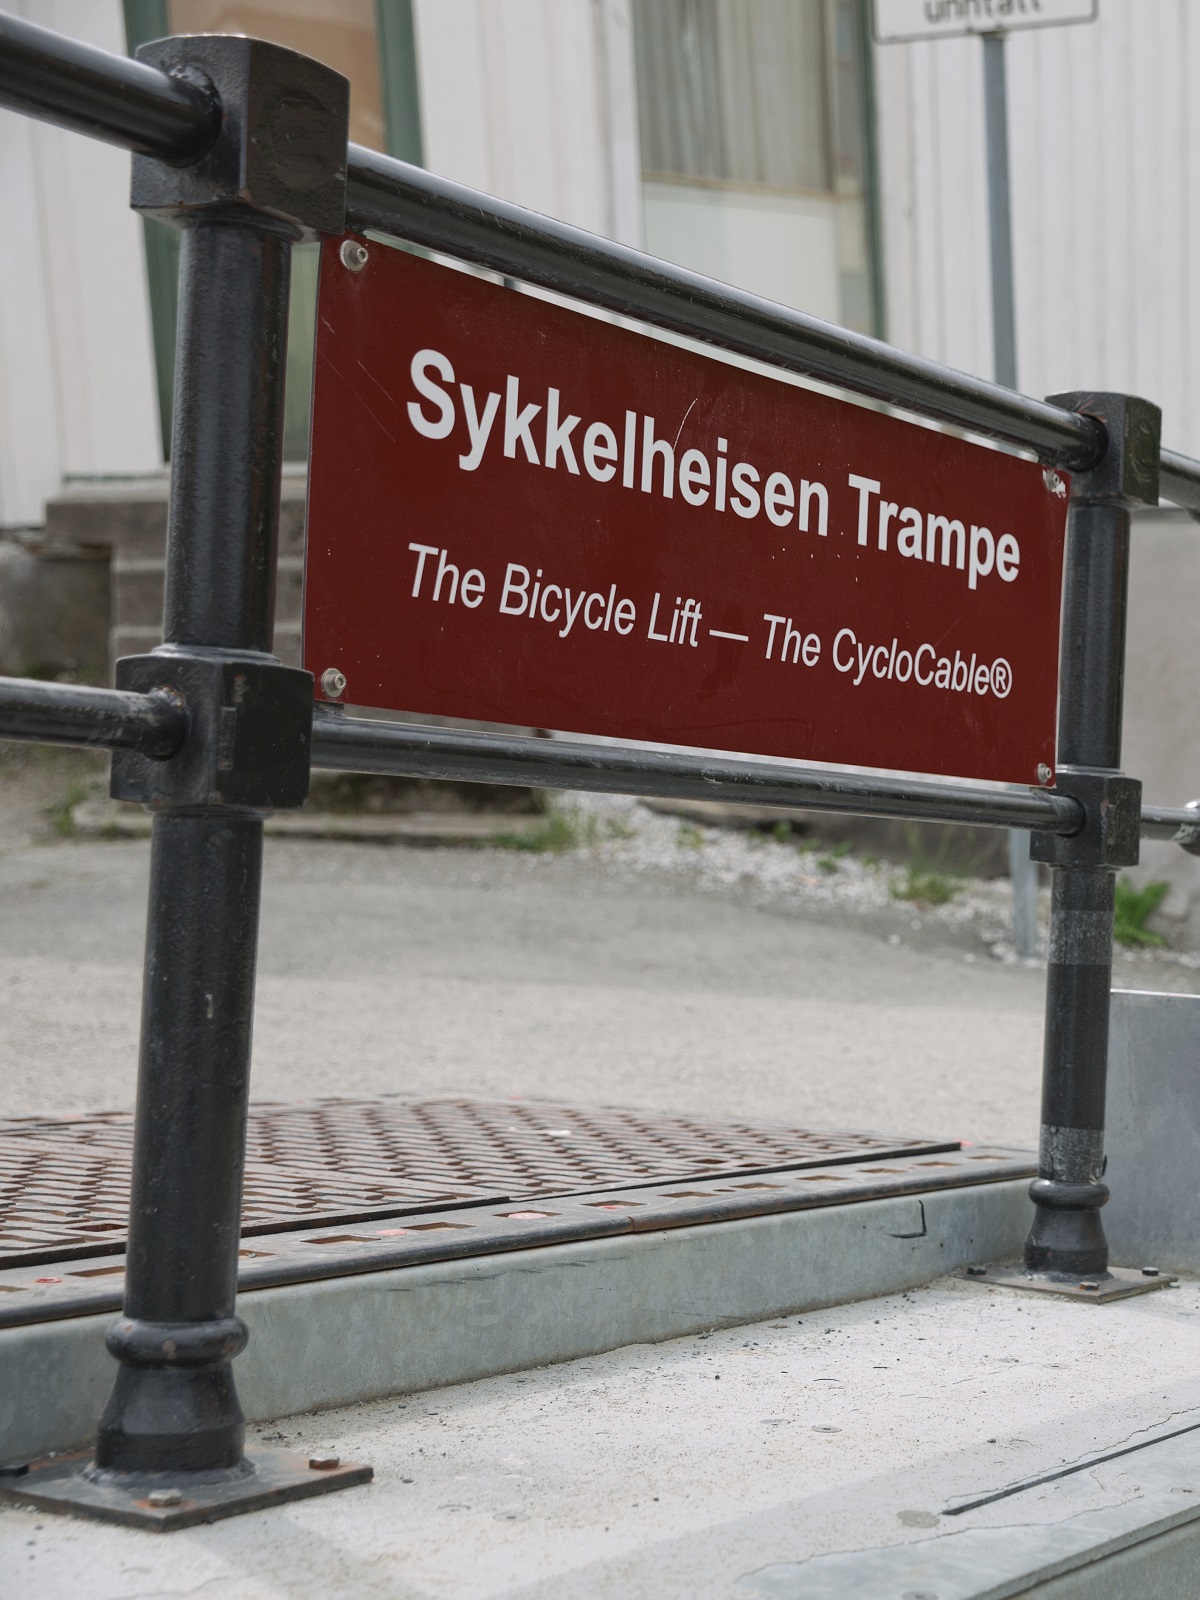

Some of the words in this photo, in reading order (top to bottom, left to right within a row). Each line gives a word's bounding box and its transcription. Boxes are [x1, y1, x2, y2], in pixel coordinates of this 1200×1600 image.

[407, 349, 828, 536] Sykkelheisen
[849, 474, 1019, 590] Trampe
[409, 543, 485, 608] The
[500, 563, 635, 637] Bicycle
[648, 593, 702, 647] Lift
[764, 614, 820, 666] The
[833, 629, 1012, 698] CycloCable®
